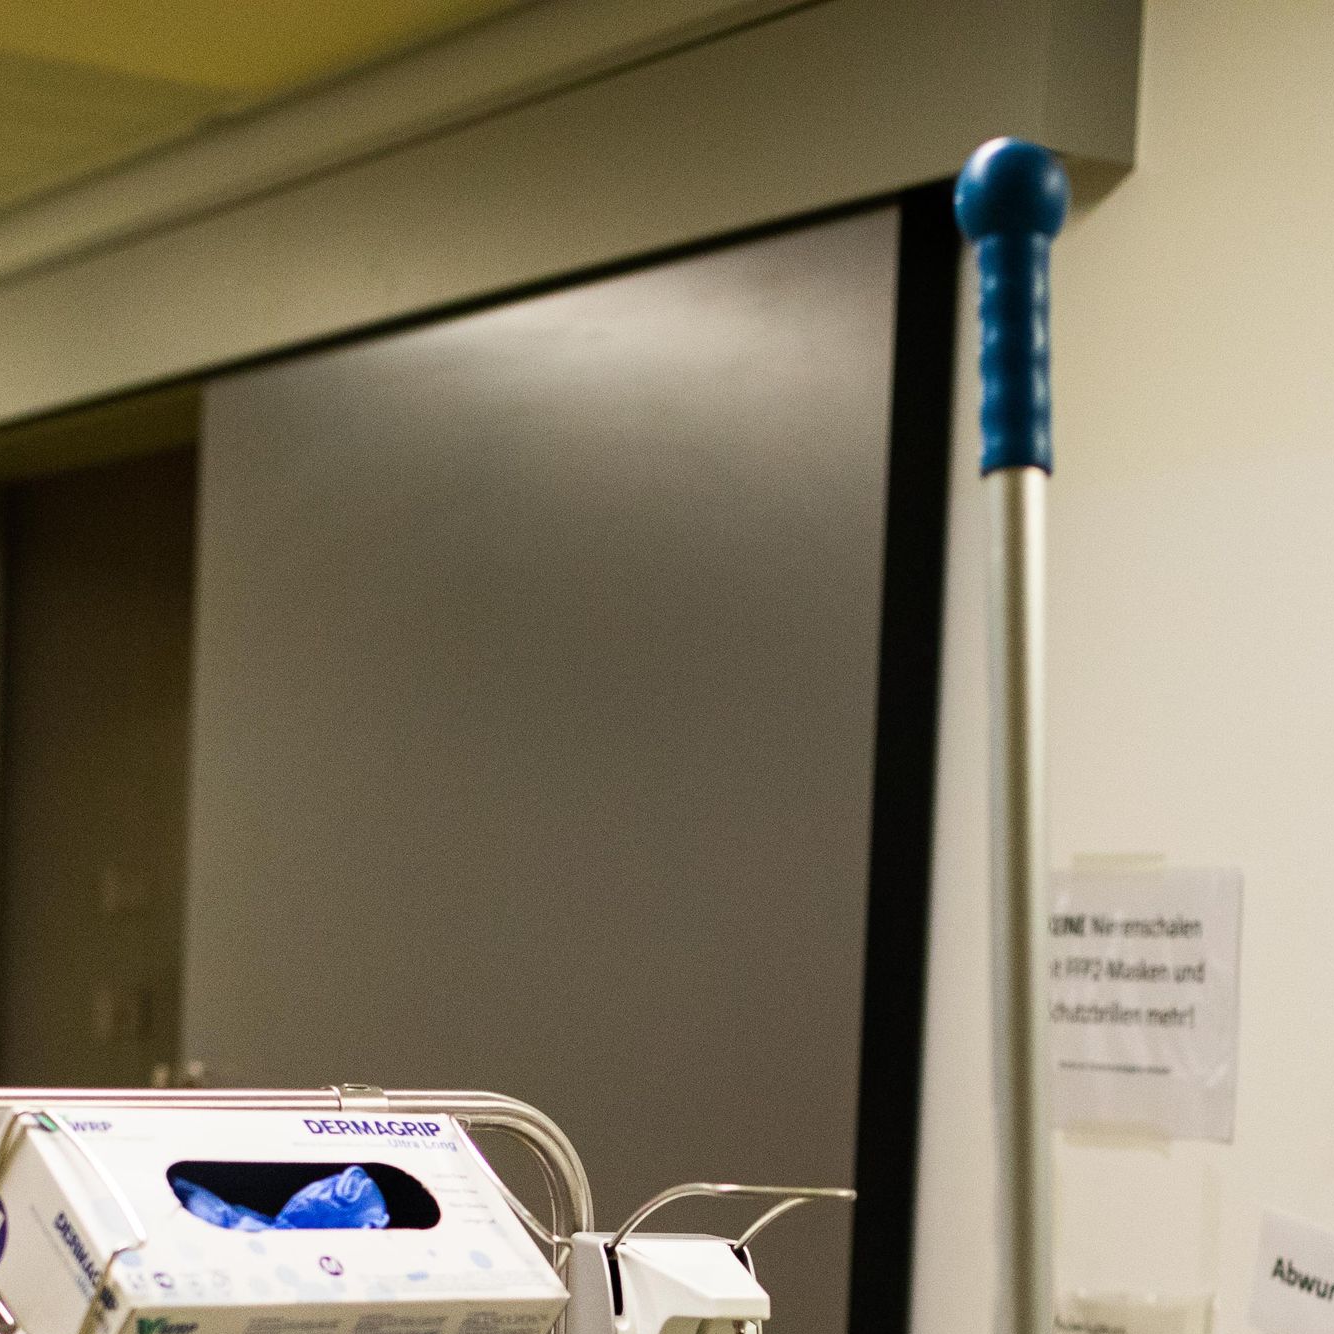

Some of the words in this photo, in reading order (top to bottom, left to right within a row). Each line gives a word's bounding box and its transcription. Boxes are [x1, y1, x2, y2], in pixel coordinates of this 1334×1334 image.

[1173, 960, 1206, 985] und
[303, 1118, 442, 1137] DERMAGRIP
[387, 1138, 421, 1149] Ultra
[423, 1139, 458, 1152] Long
